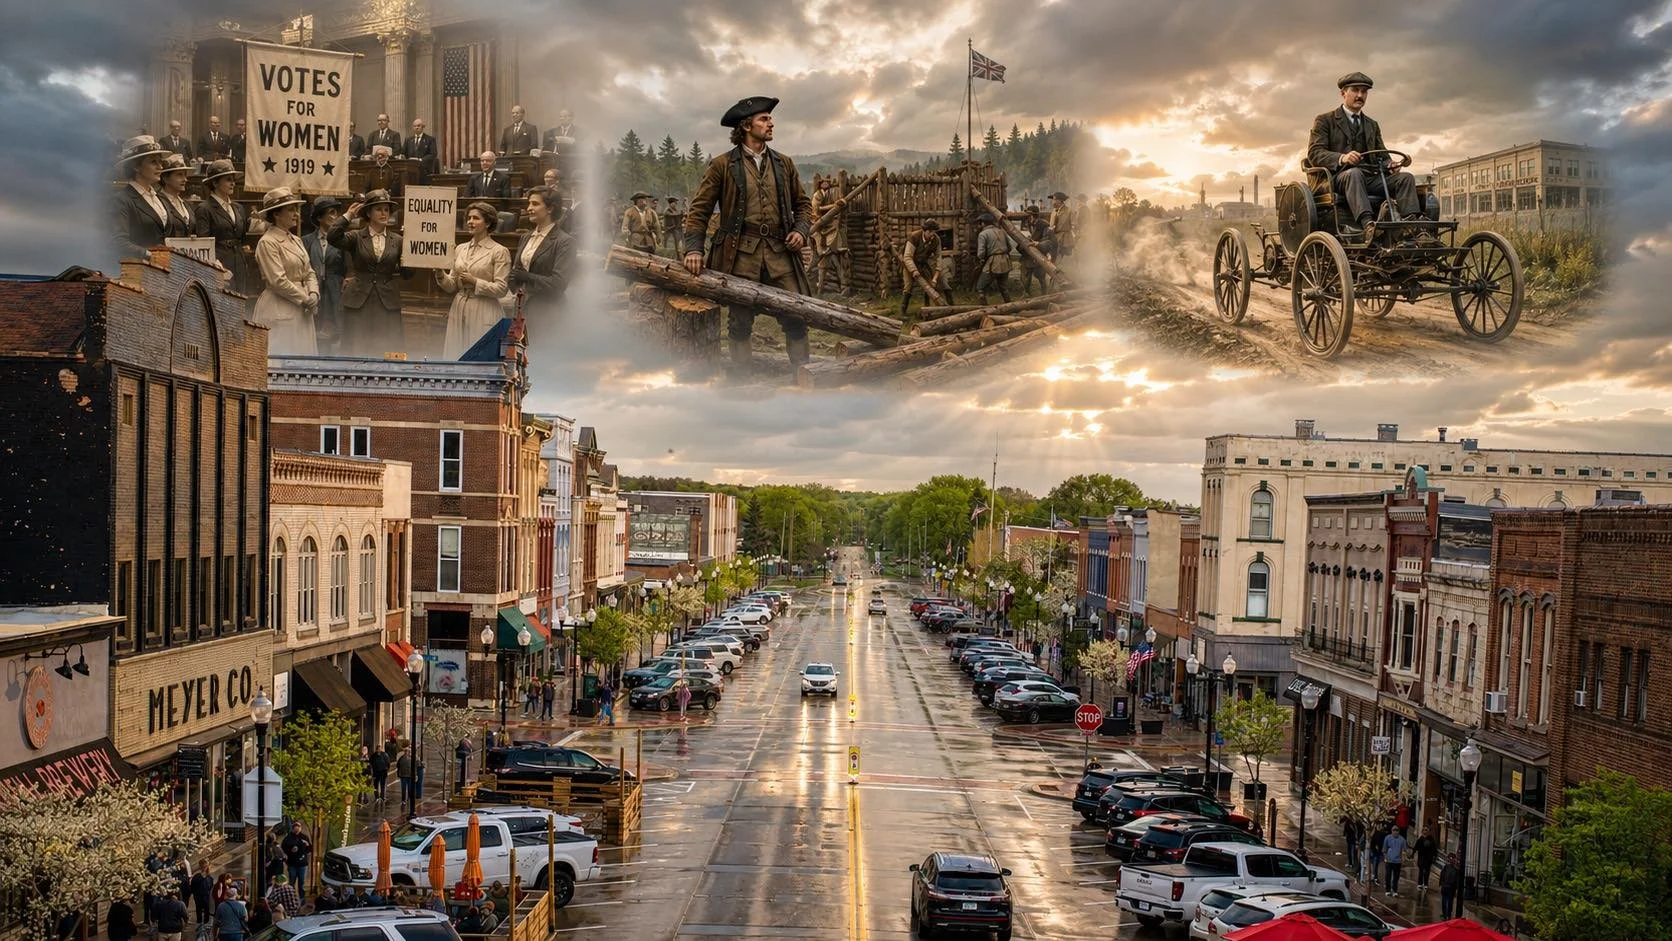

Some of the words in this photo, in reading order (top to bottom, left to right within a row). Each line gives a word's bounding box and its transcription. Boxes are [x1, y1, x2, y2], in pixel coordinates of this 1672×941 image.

[259, 63, 341, 98] VOTES
[287, 100, 315, 117] FOR
[257, 119, 340, 152] WOMEN
[285, 157, 315, 175] 1919
[408, 198, 453, 215] EQUALITY
[421, 221, 437, 233] FOR
[410, 240, 447, 256] WOMEN
[149, 673, 220, 736] MEYER
[1077, 711, 1101, 723] STOP
